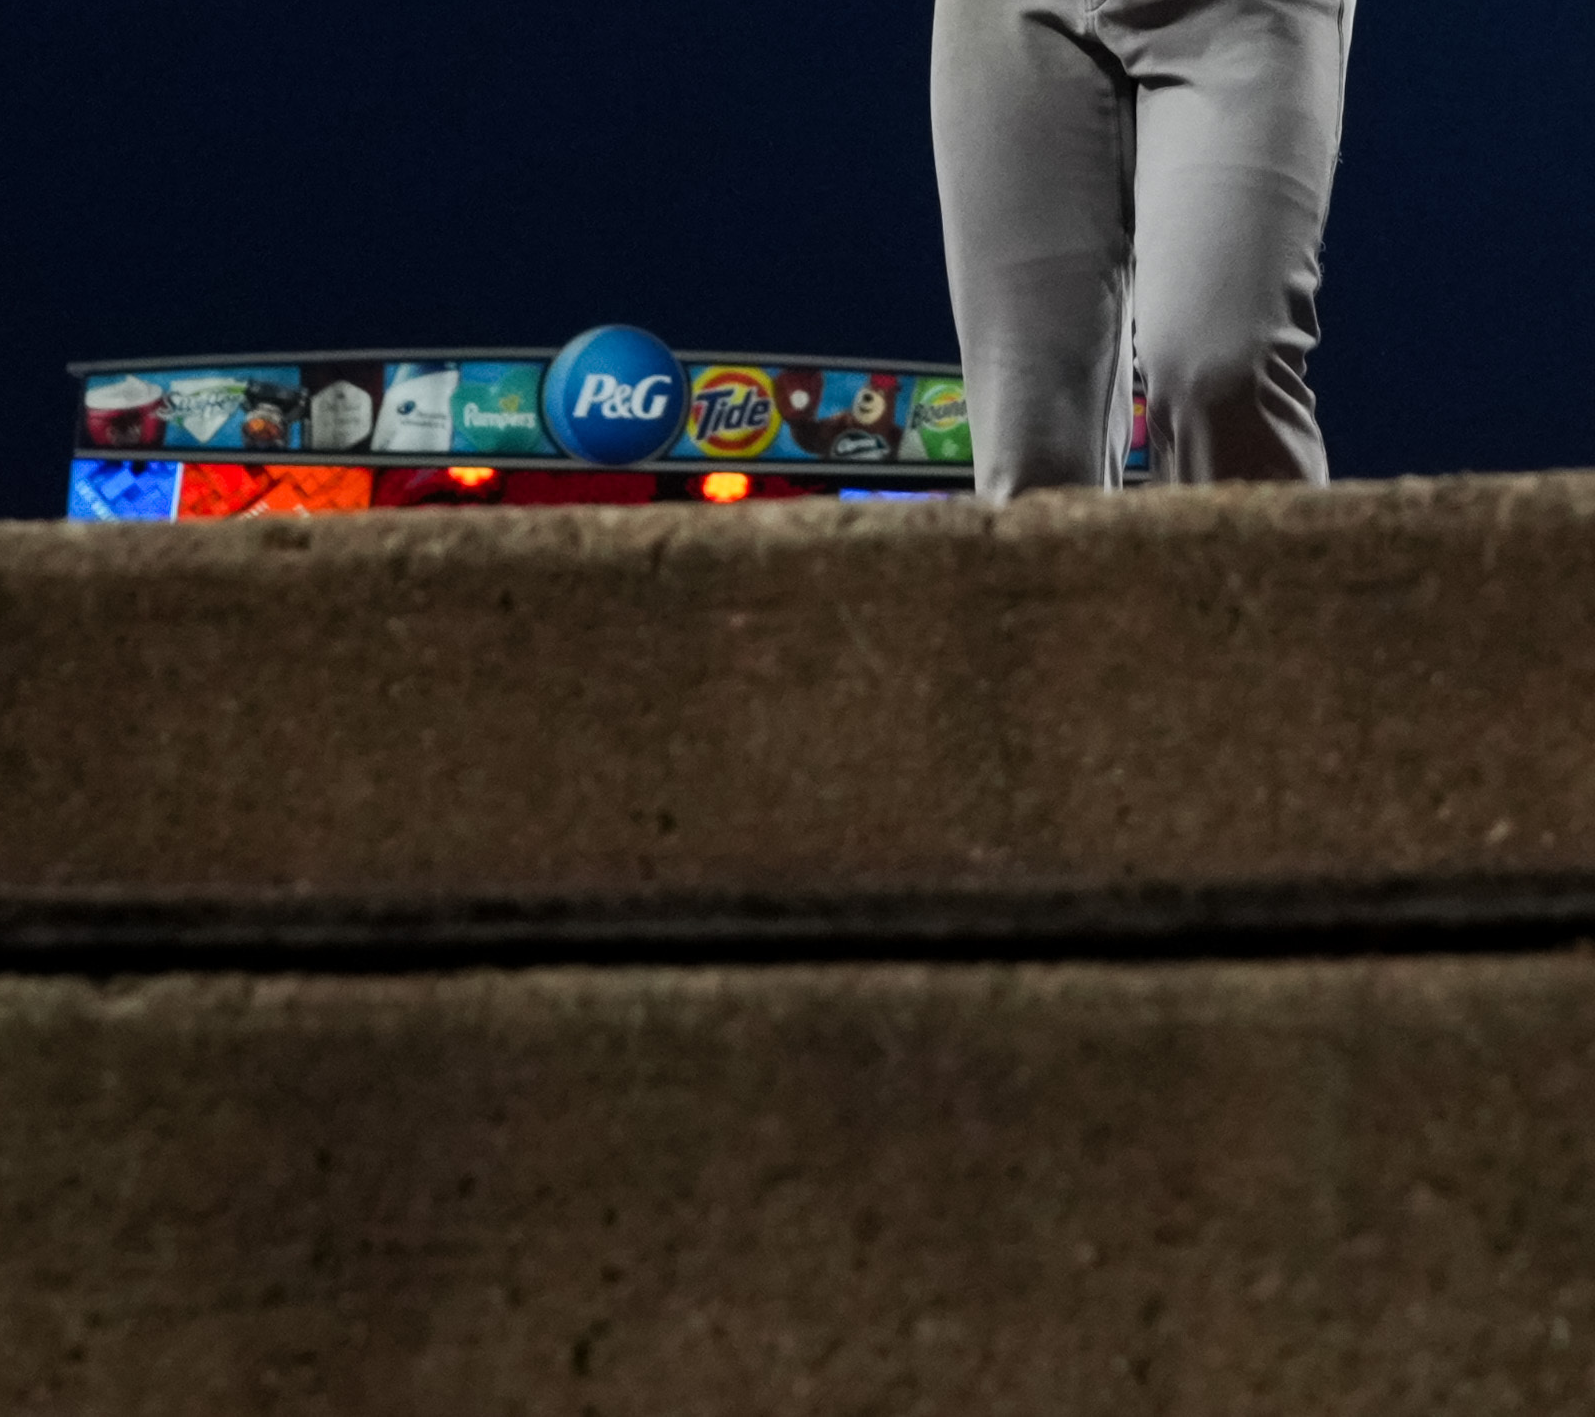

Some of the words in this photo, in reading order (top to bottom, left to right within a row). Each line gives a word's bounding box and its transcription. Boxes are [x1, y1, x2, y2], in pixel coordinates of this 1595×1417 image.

[463, 402, 537, 430] Pampers
[572, 372, 673, 420] P&G
[695, 385, 772, 442] Tide
